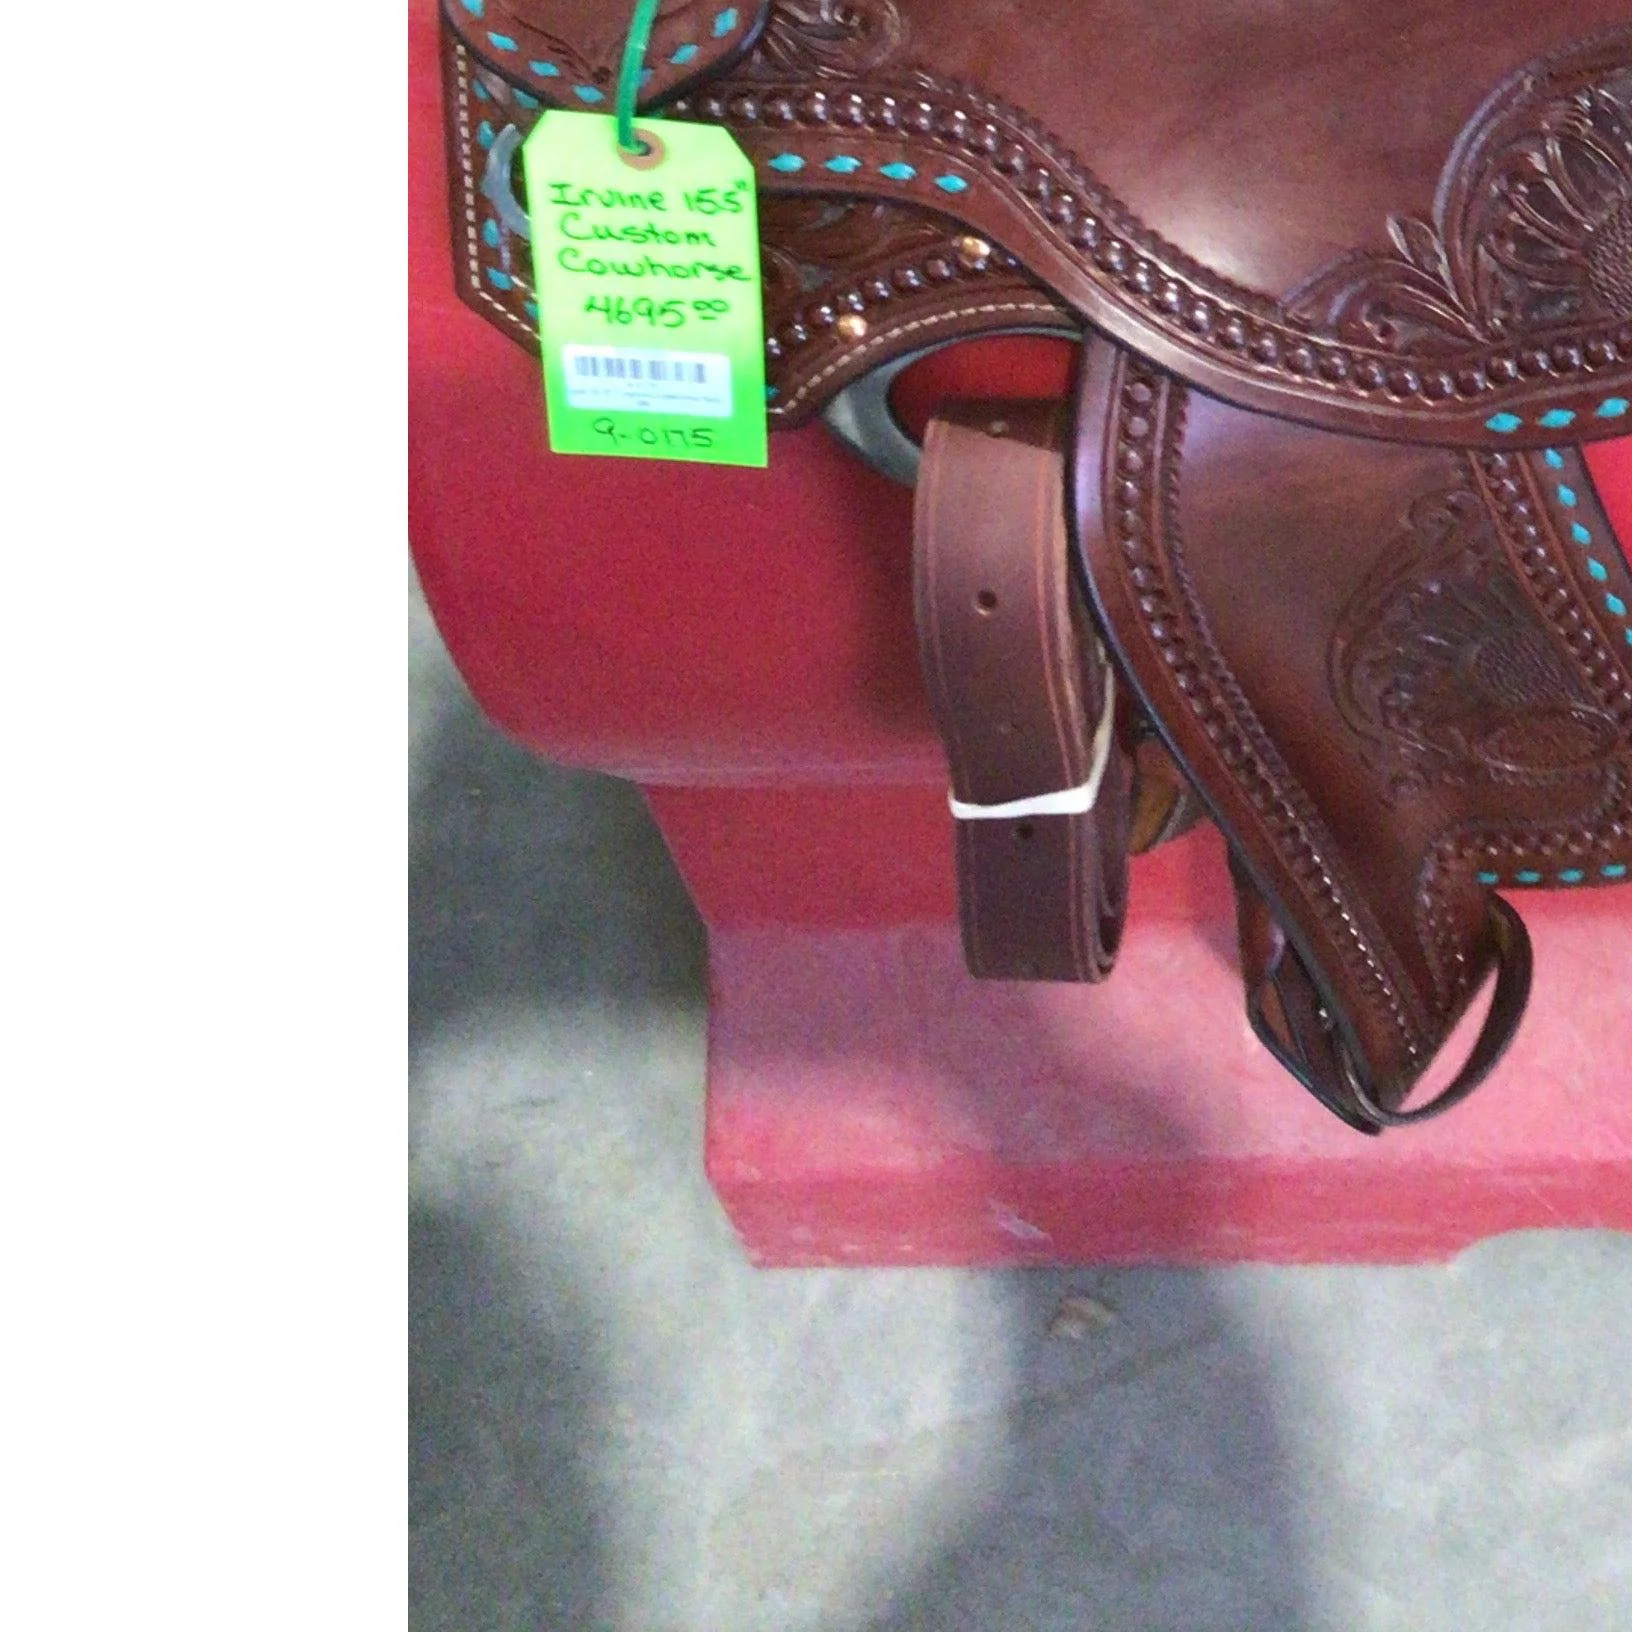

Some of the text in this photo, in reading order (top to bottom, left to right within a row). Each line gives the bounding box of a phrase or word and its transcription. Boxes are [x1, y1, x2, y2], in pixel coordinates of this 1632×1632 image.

[549, 183, 667, 212] Irvine
[559, 212, 716, 246] Custom
[558, 247, 751, 281] Cowhorse
